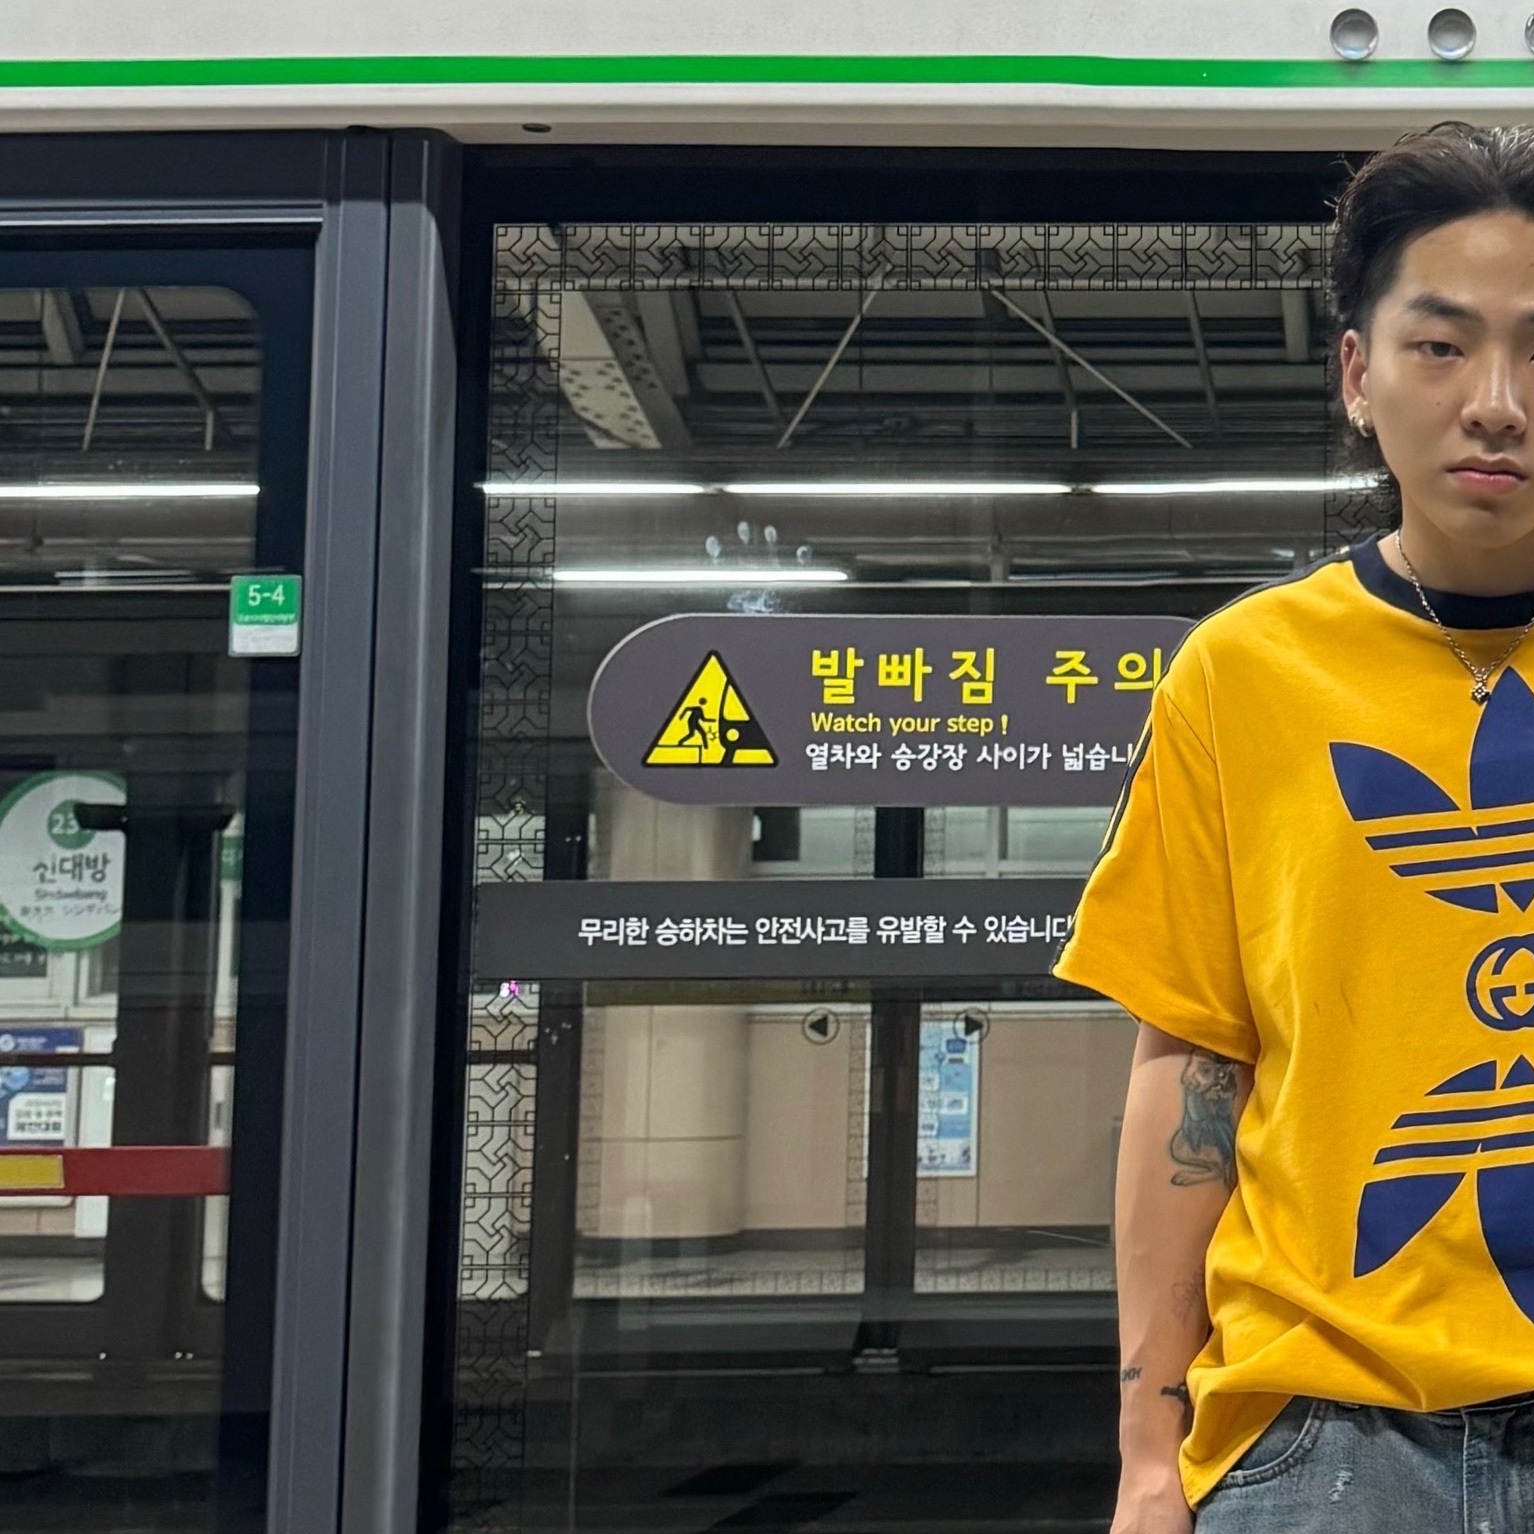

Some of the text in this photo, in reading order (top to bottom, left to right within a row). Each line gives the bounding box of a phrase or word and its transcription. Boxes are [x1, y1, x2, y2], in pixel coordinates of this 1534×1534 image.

[248, 584, 285, 606] 5-4
[811, 647, 995, 704] 발빠짐
[811, 713, 882, 733] Watch
[889, 717, 938, 735] your
[946, 716, 994, 735] step
[805, 742, 883, 771] 열차와
[891, 742, 968, 772] 승강장
[976, 742, 1053, 770] 사이가
[52, 812, 91, 836] 23
[32, 852, 112, 885] 신대방
[578, 917, 650, 946] 무리한
[654, 917, 749, 946] 승하차는
[755, 915, 868, 946] 안전사고를
[876, 914, 947, 945] 유발할
[951, 914, 977, 943] 수
